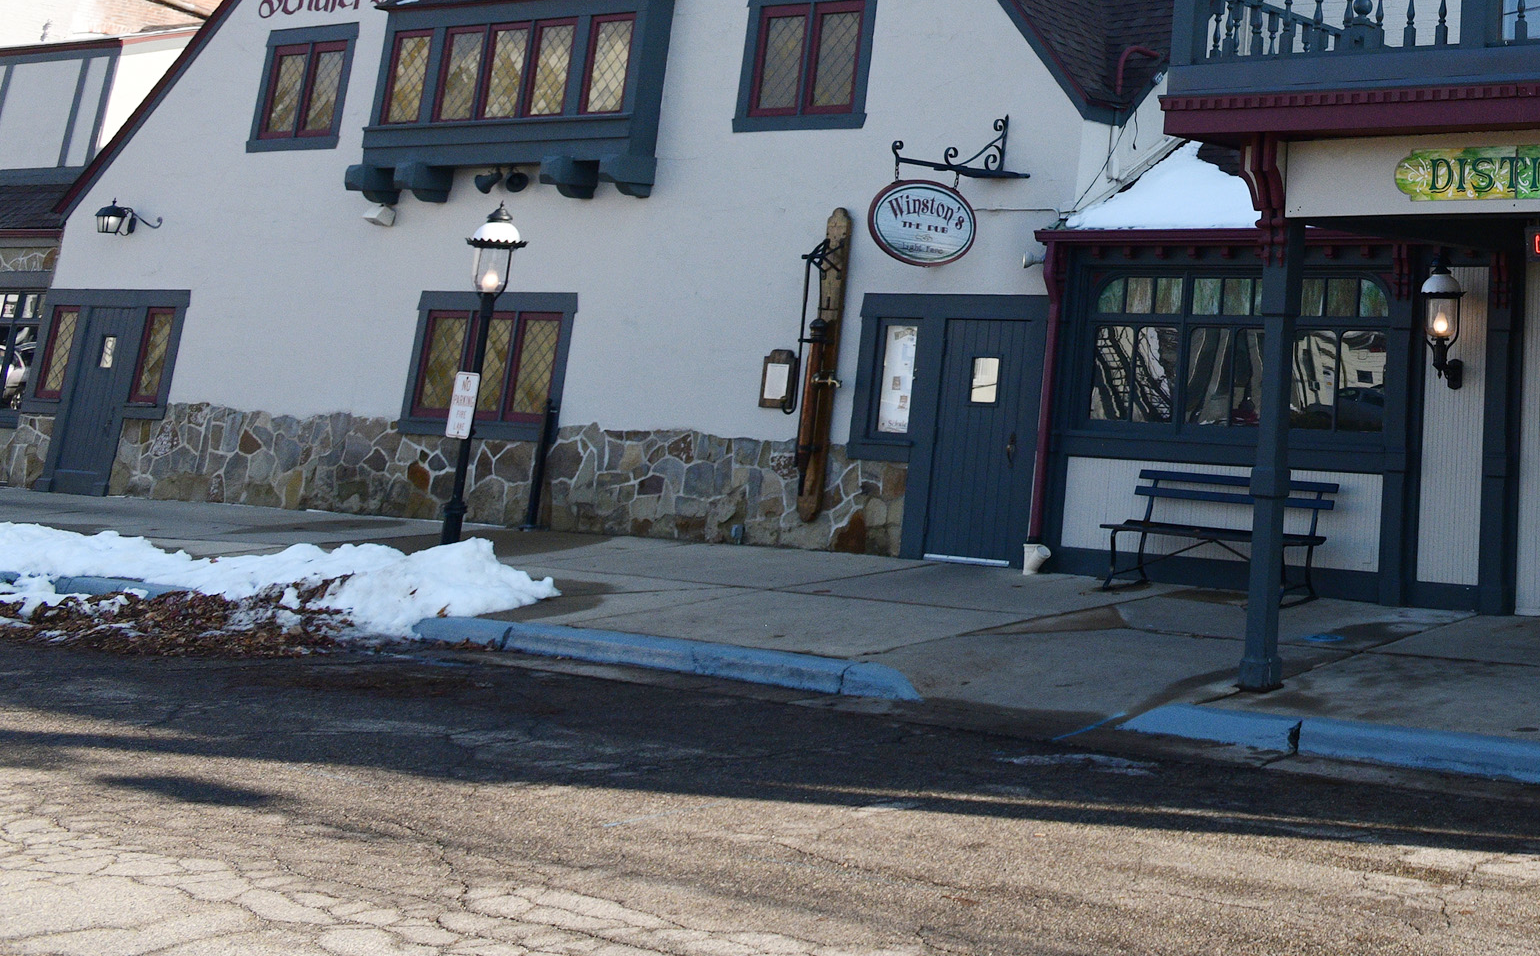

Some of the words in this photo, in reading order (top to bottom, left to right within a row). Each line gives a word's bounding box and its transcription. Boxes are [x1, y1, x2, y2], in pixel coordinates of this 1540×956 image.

[888, 195, 965, 230] Winston's
[902, 221, 922, 230] THE
[927, 225, 948, 234] PUB
[462, 379, 472, 391] NO
[453, 394, 475, 407] PARKING
